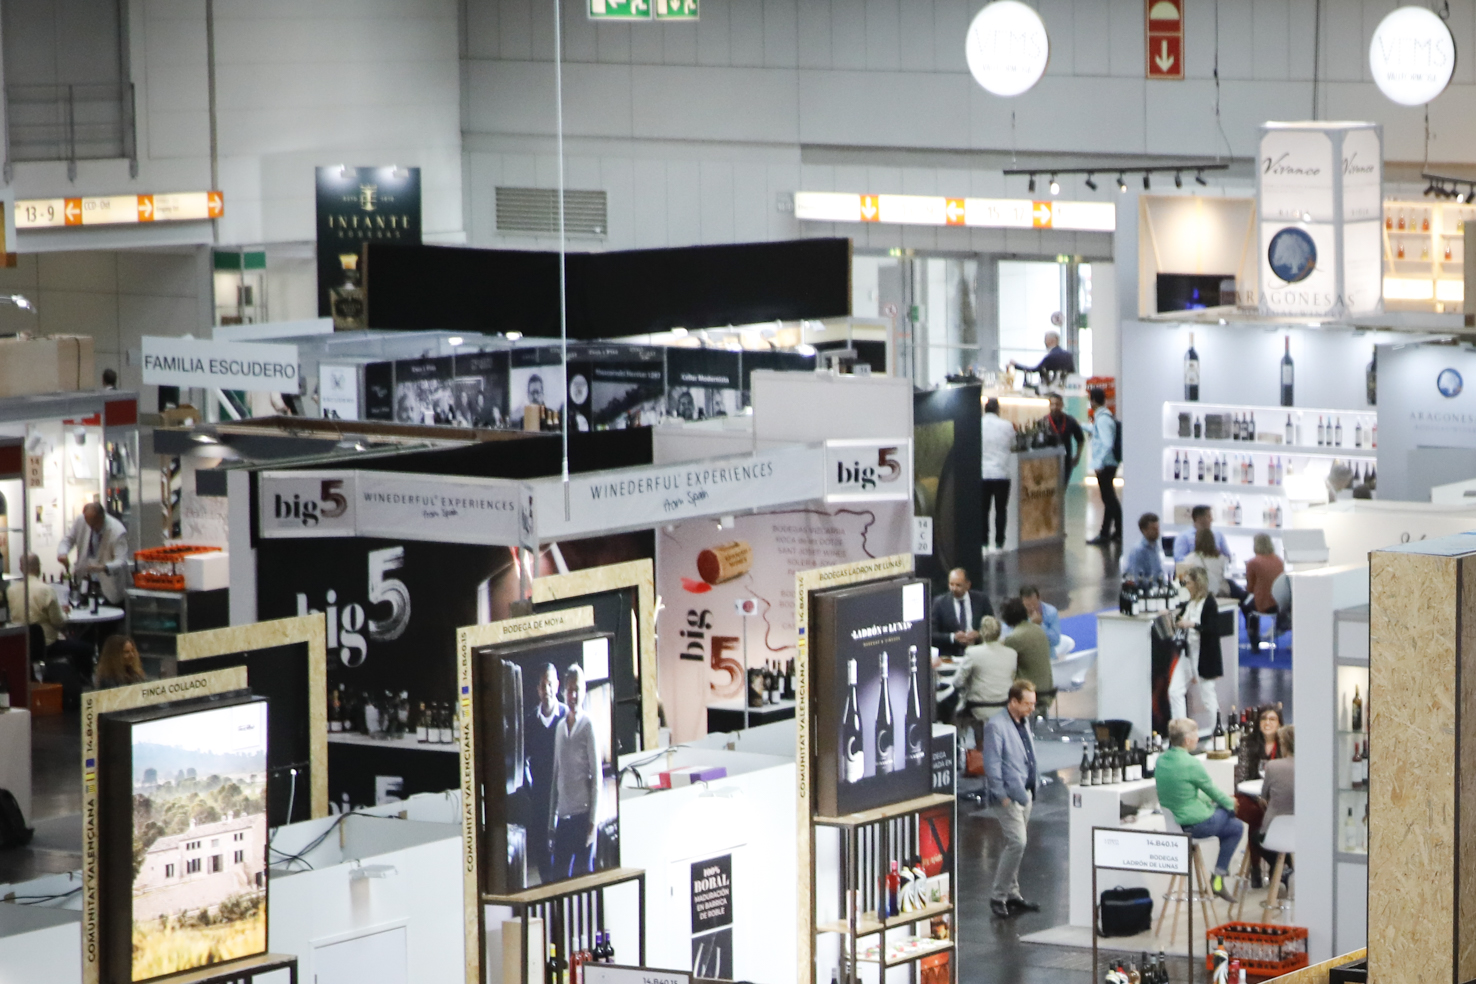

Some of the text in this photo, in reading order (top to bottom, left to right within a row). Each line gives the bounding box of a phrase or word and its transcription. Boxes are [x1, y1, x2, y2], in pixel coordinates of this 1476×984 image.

[1262, 153, 1321, 177] Vivanco
[25, 205, 55, 223] 13 9
[328, 214, 410, 229] INFANTE
[145, 355, 297, 380] FAMILIA ESCUDERO
[590, 461, 774, 500] WINEDERFUL EXPERIENCES
[274, 479, 348, 527] big5
[363, 492, 516, 512] WINEDERFUL EXPERIENCES
[917, 519, 928, 529] 14
[919, 532, 925, 541] C
[917, 542, 928, 552] 20
[819, 569, 848, 582] BODEGAS
[874, 563, 882, 572] DE
[883, 559, 902, 570] LUNAS
[503, 616, 564, 635] BODEGA DE MOYA
[142, 678, 208, 698] FINCA COLLADO
[464, 722, 475, 874] COMUNITAT VALENCIANA
[1146, 839, 1179, 848] 14.B40.14
[1123, 858, 1148, 867] LADRÓN
[1160, 861, 1179, 869] LUNAS
[1149, 854, 1179, 862] BODEGAS
[86, 798, 97, 963] COMUNITAT VALENCIANA
